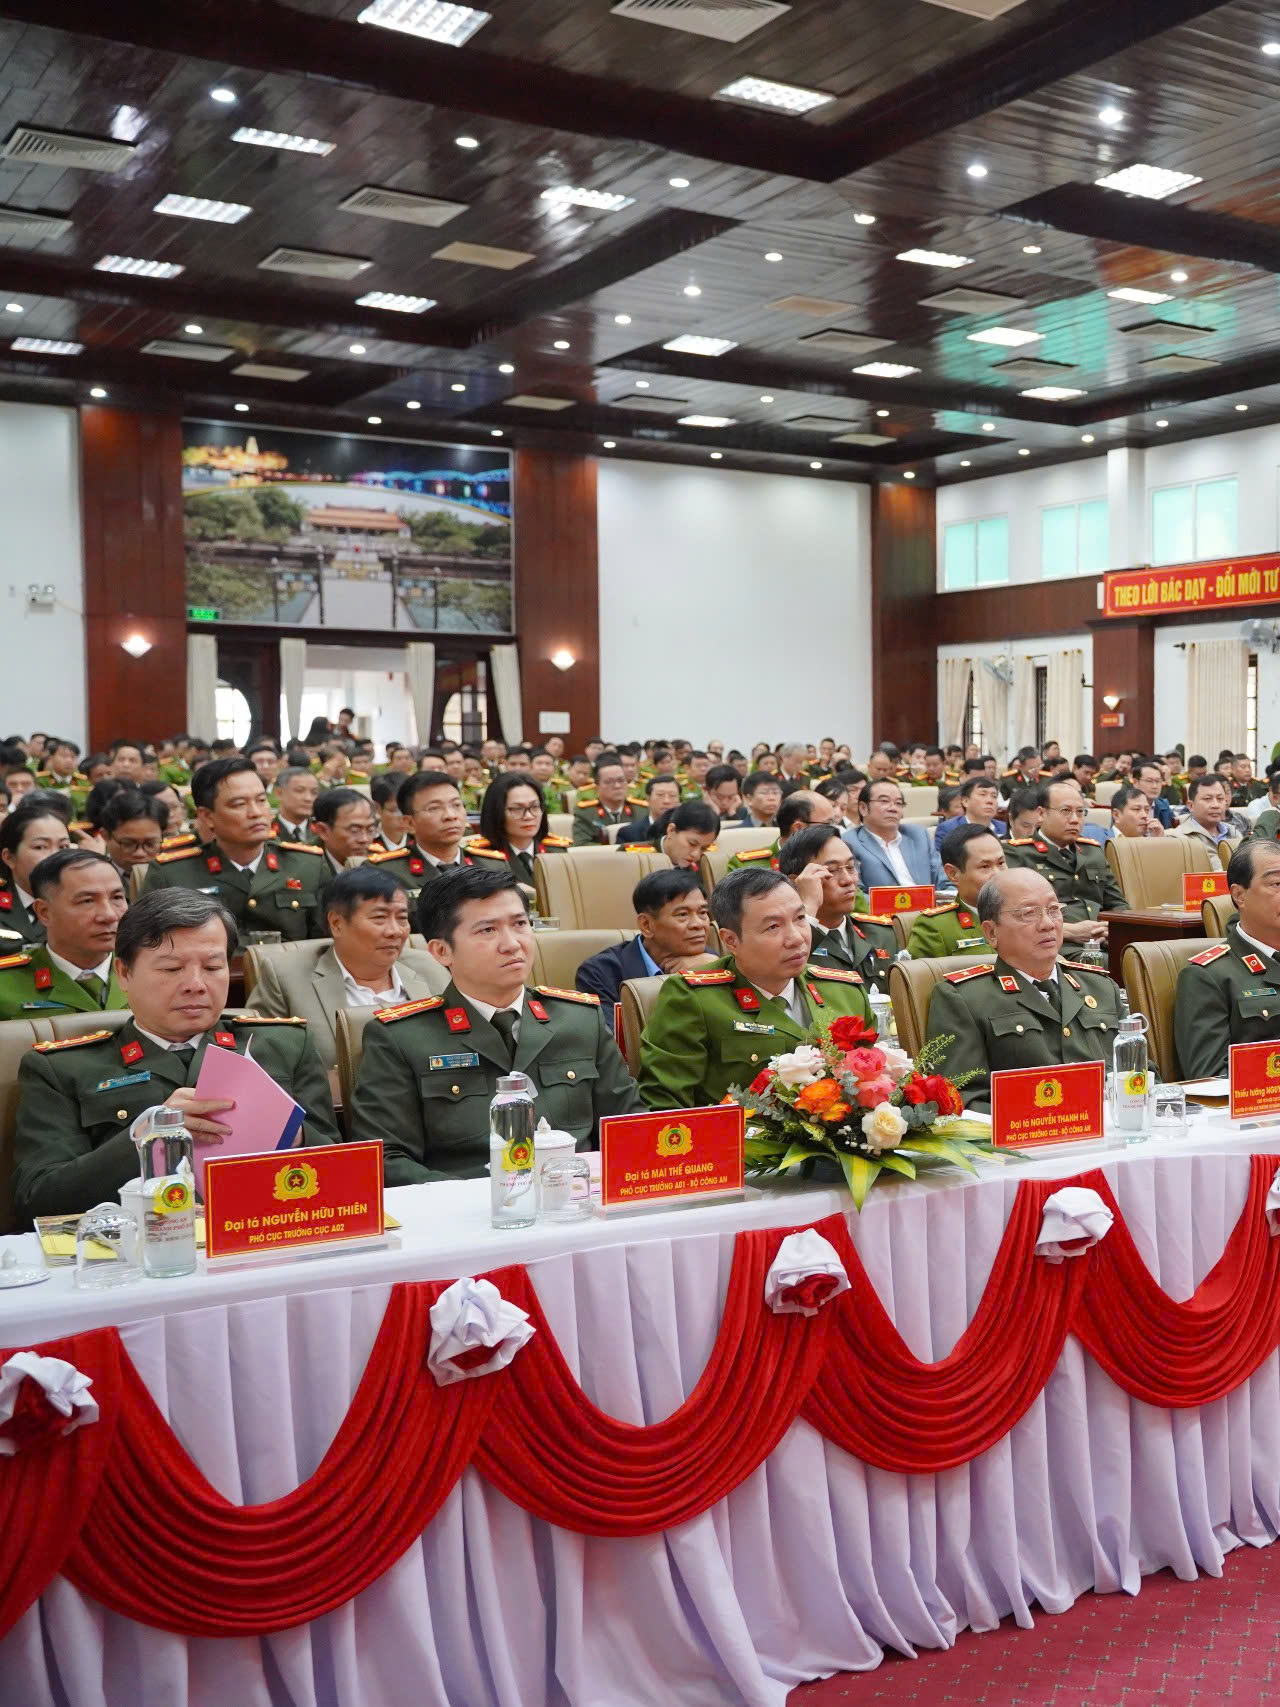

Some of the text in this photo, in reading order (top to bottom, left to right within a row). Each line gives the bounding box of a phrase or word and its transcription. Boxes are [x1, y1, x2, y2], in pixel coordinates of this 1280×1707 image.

[1115, 585, 1139, 607] THEO
[1142, 578, 1158, 604] LỜI
[1161, 577, 1182, 602] BÁC
[1185, 578, 1206, 605] DẠY
[1216, 566, 1234, 598] ĐỔI
[1238, 567, 1261, 595] MỚI
[1264, 568, 1280, 592] TƯ
[1235, 1088, 1248, 1098] Thiếu
[1250, 1088, 1265, 1097] tướng
[1011, 1120, 1021, 1131] Đại
[1023, 1119, 1029, 1127] tá
[1031, 1113, 1056, 1126] NGUYỄN
[1058, 1114, 1078, 1123] THANH
[625, 1162, 713, 1183] Đại tá MAI THẾ QUANG
[620, 1186, 633, 1196] PHÓ
[635, 1185, 648, 1195] CỤC
[650, 1182, 673, 1192] TRƯỞNG
[690, 1178, 698, 1188] BỘ
[700, 1177, 718, 1185] CÔNG
[224, 1203, 368, 1233] Đại tá NGUYỄN HỮU THIÊN
[249, 1224, 344, 1243] PHÓ CỤC TRƯỞNG CỤC A02
